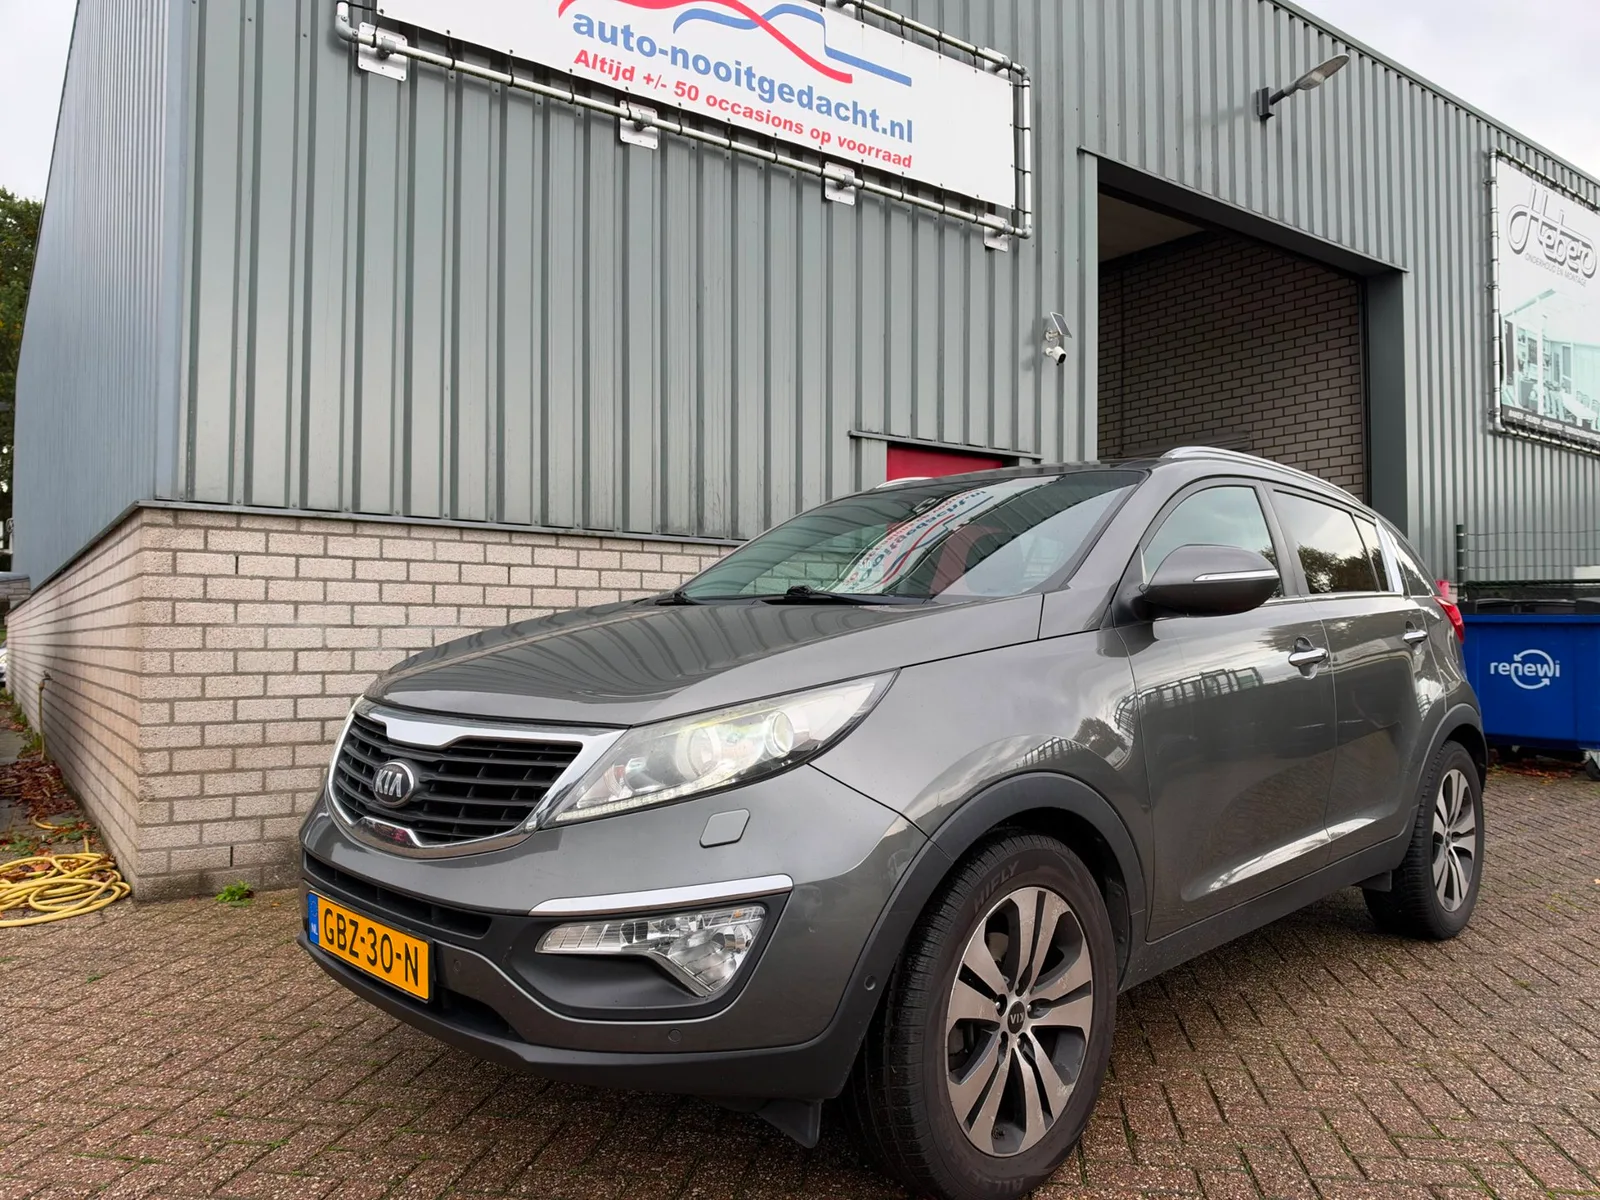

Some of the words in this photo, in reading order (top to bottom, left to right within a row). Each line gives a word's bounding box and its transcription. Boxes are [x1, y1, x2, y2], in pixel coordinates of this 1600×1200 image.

[573, 13, 913, 143] auto-nooitgedacht.nl
[574, 49, 635, 82] Altijd
[643, 71, 667, 91] +/-
[674, 80, 700, 102] 50
[705, 94, 804, 135] occasions
[810, 125, 832, 145] op
[837, 136, 912, 169] voorraad
[1490, 660, 1560, 677] renewi
[375, 769, 403, 797] KIA
[974, 860, 1019, 914] HIFLY
[311, 922, 318, 936] NL
[324, 908, 418, 987] GBZ-30-N
[1010, 1011, 1024, 1024] KIA
